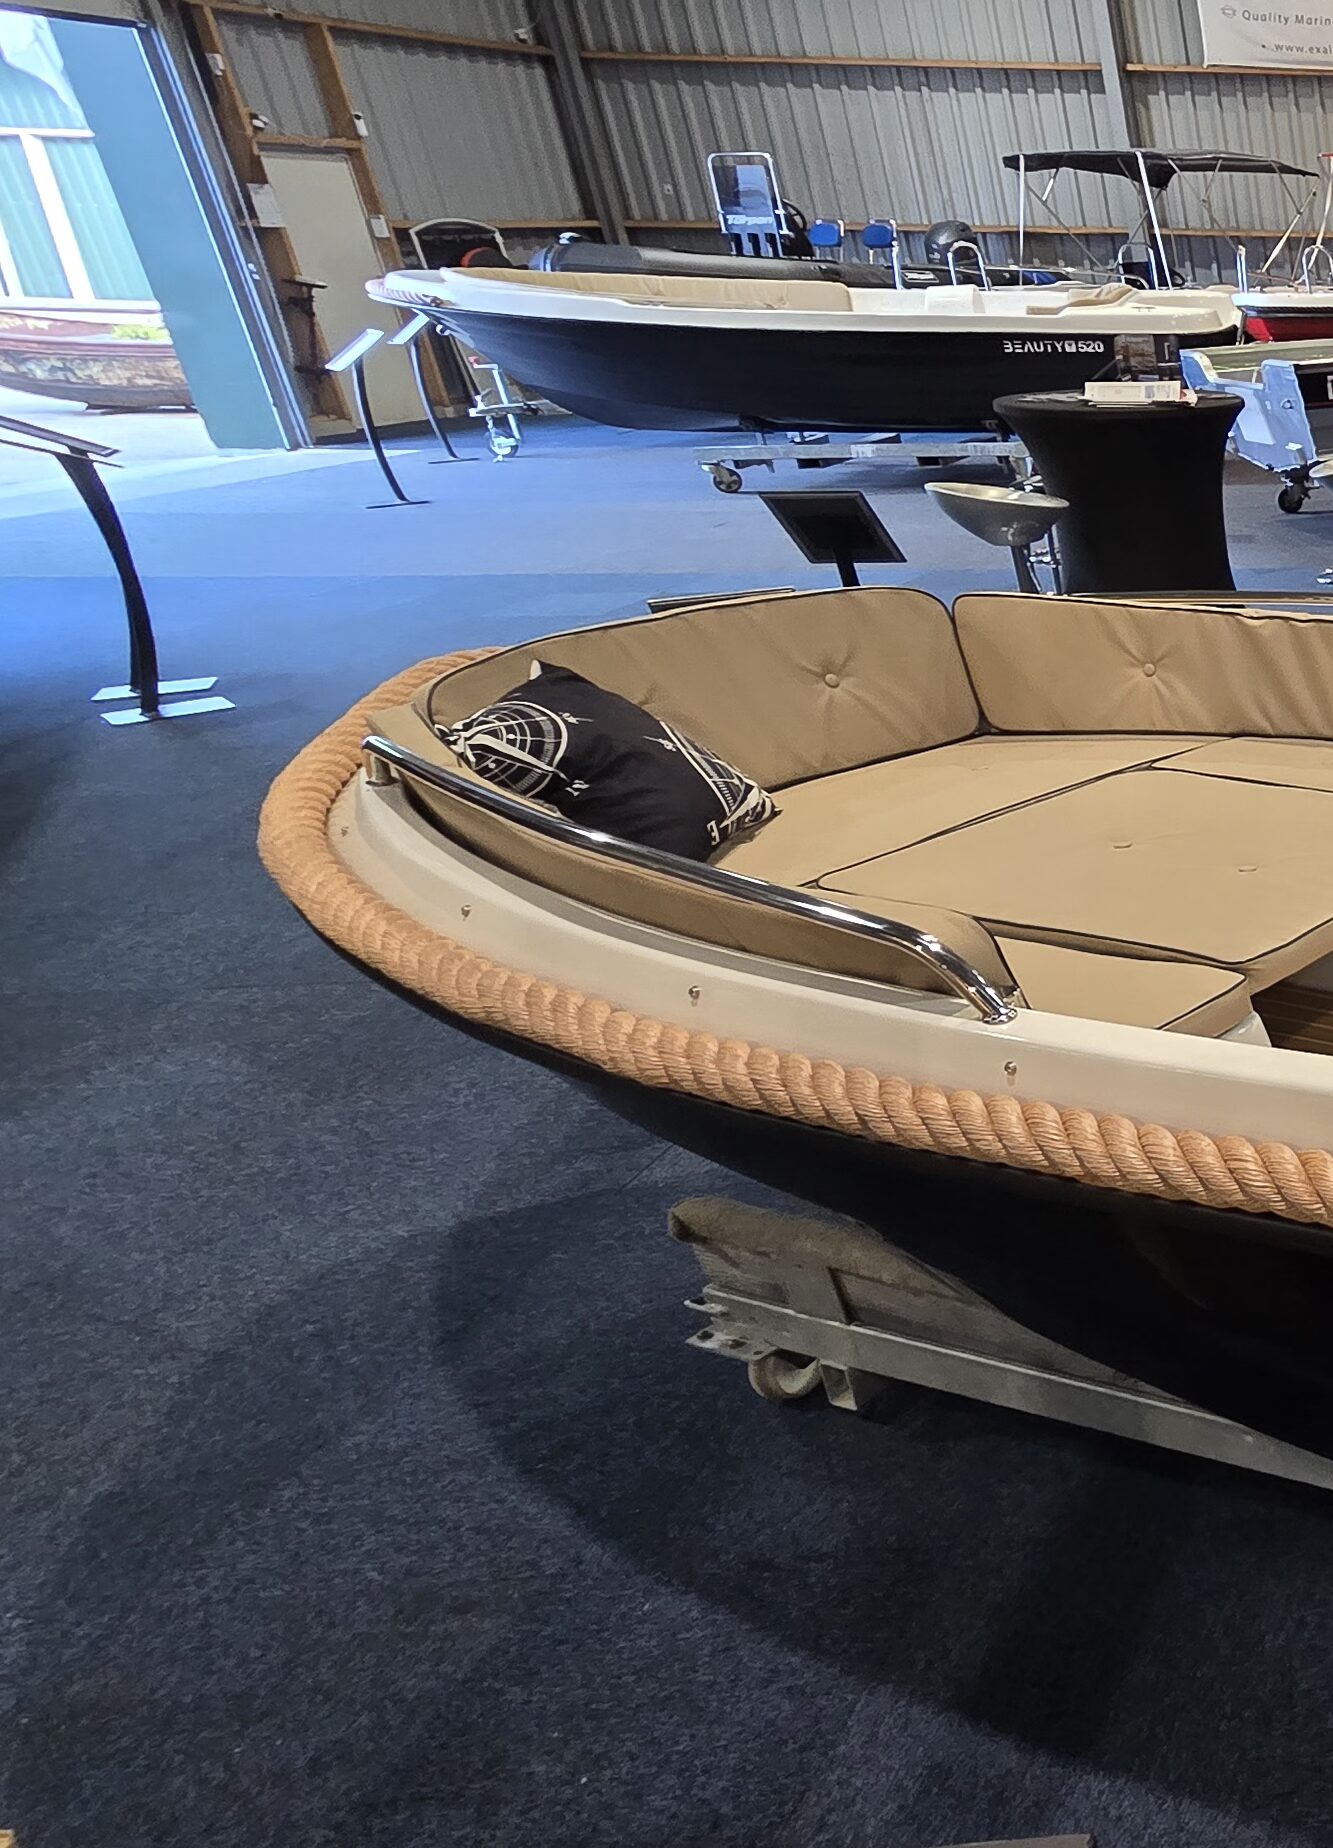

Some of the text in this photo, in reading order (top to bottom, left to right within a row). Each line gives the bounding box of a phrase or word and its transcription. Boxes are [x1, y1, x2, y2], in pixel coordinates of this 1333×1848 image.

[1242, 10, 1289, 25] Quality
[1003, 340, 1104, 353] BEAUTY 520
